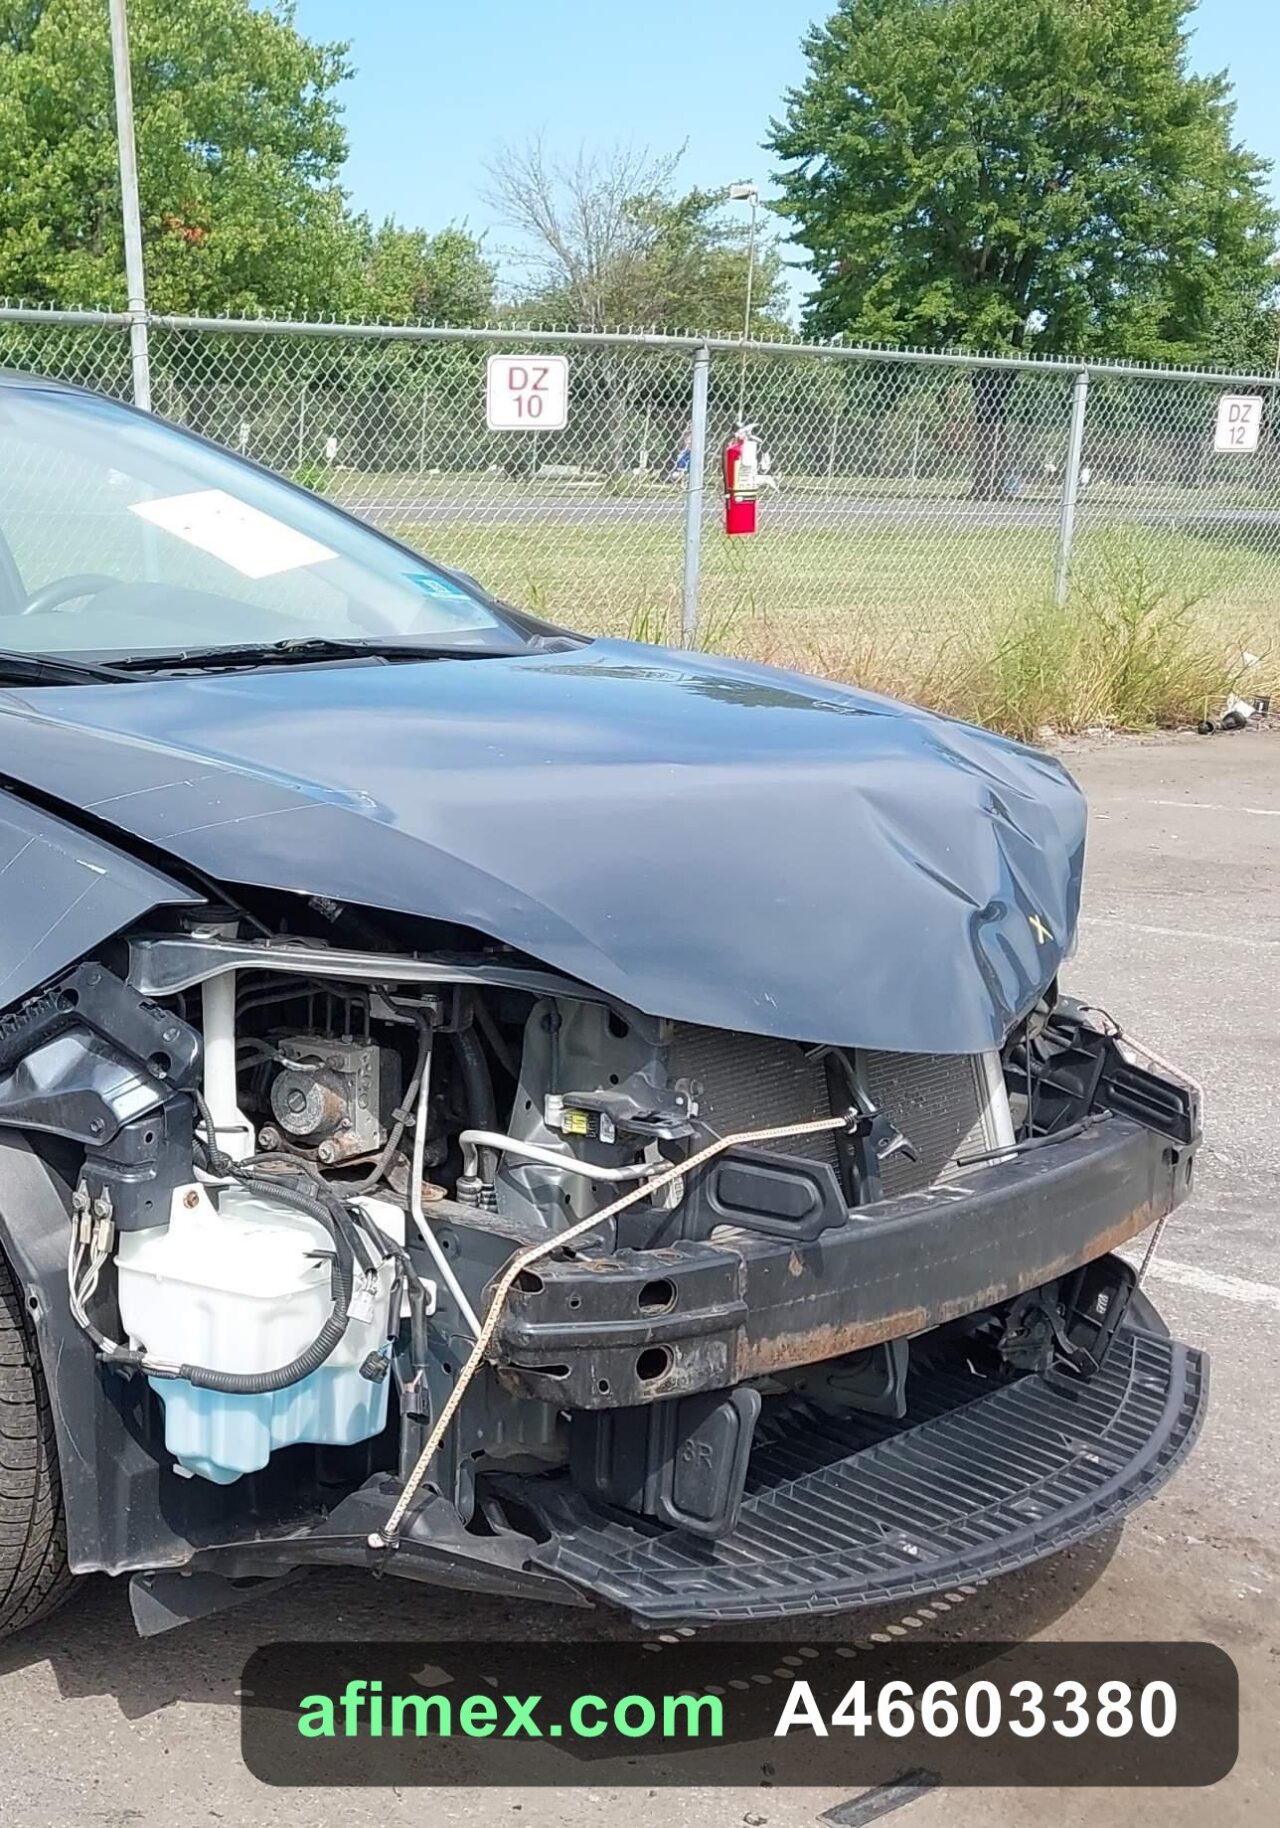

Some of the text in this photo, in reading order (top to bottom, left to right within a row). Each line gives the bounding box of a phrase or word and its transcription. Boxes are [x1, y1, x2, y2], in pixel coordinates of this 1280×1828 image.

[508, 366, 549, 391] DZ
[512, 394, 543, 418] 10
[1228, 403, 1253, 423] DZ
[1229, 425, 1246, 445] 12
